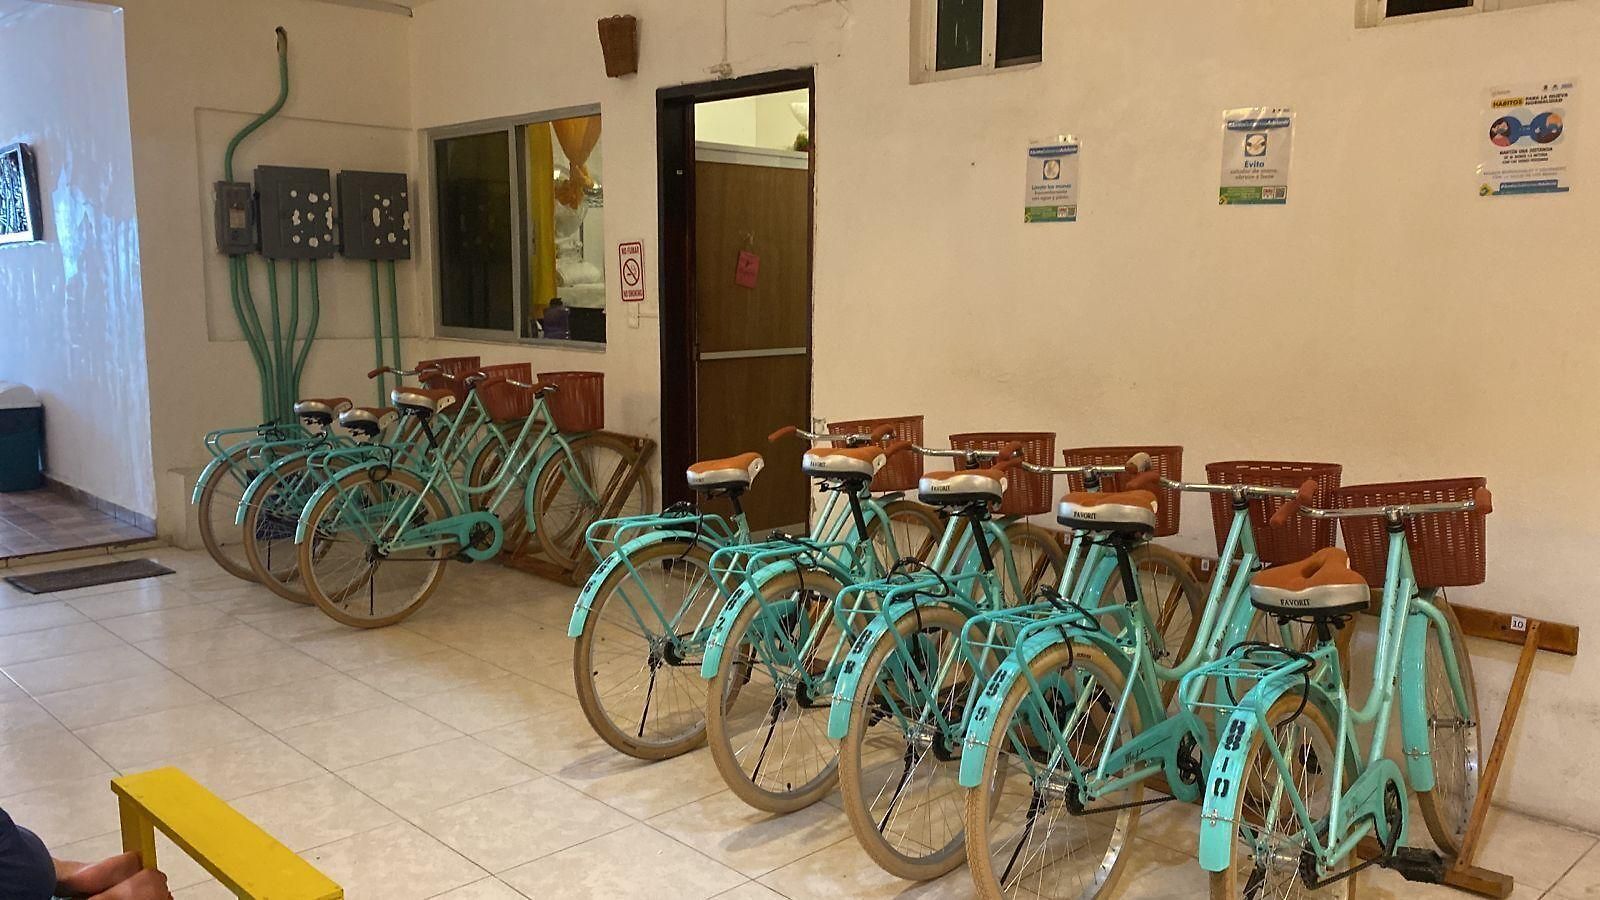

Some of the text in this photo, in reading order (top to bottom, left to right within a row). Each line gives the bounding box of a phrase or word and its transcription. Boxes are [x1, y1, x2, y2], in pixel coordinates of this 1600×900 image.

[627, 245, 639, 254] FUMAR
[629, 288, 642, 297] SMOKING
[1072, 511, 1097, 520] FAVORIT
[1280, 598, 1311, 607] FAVORIT
[1512, 620, 1524, 629] 10
